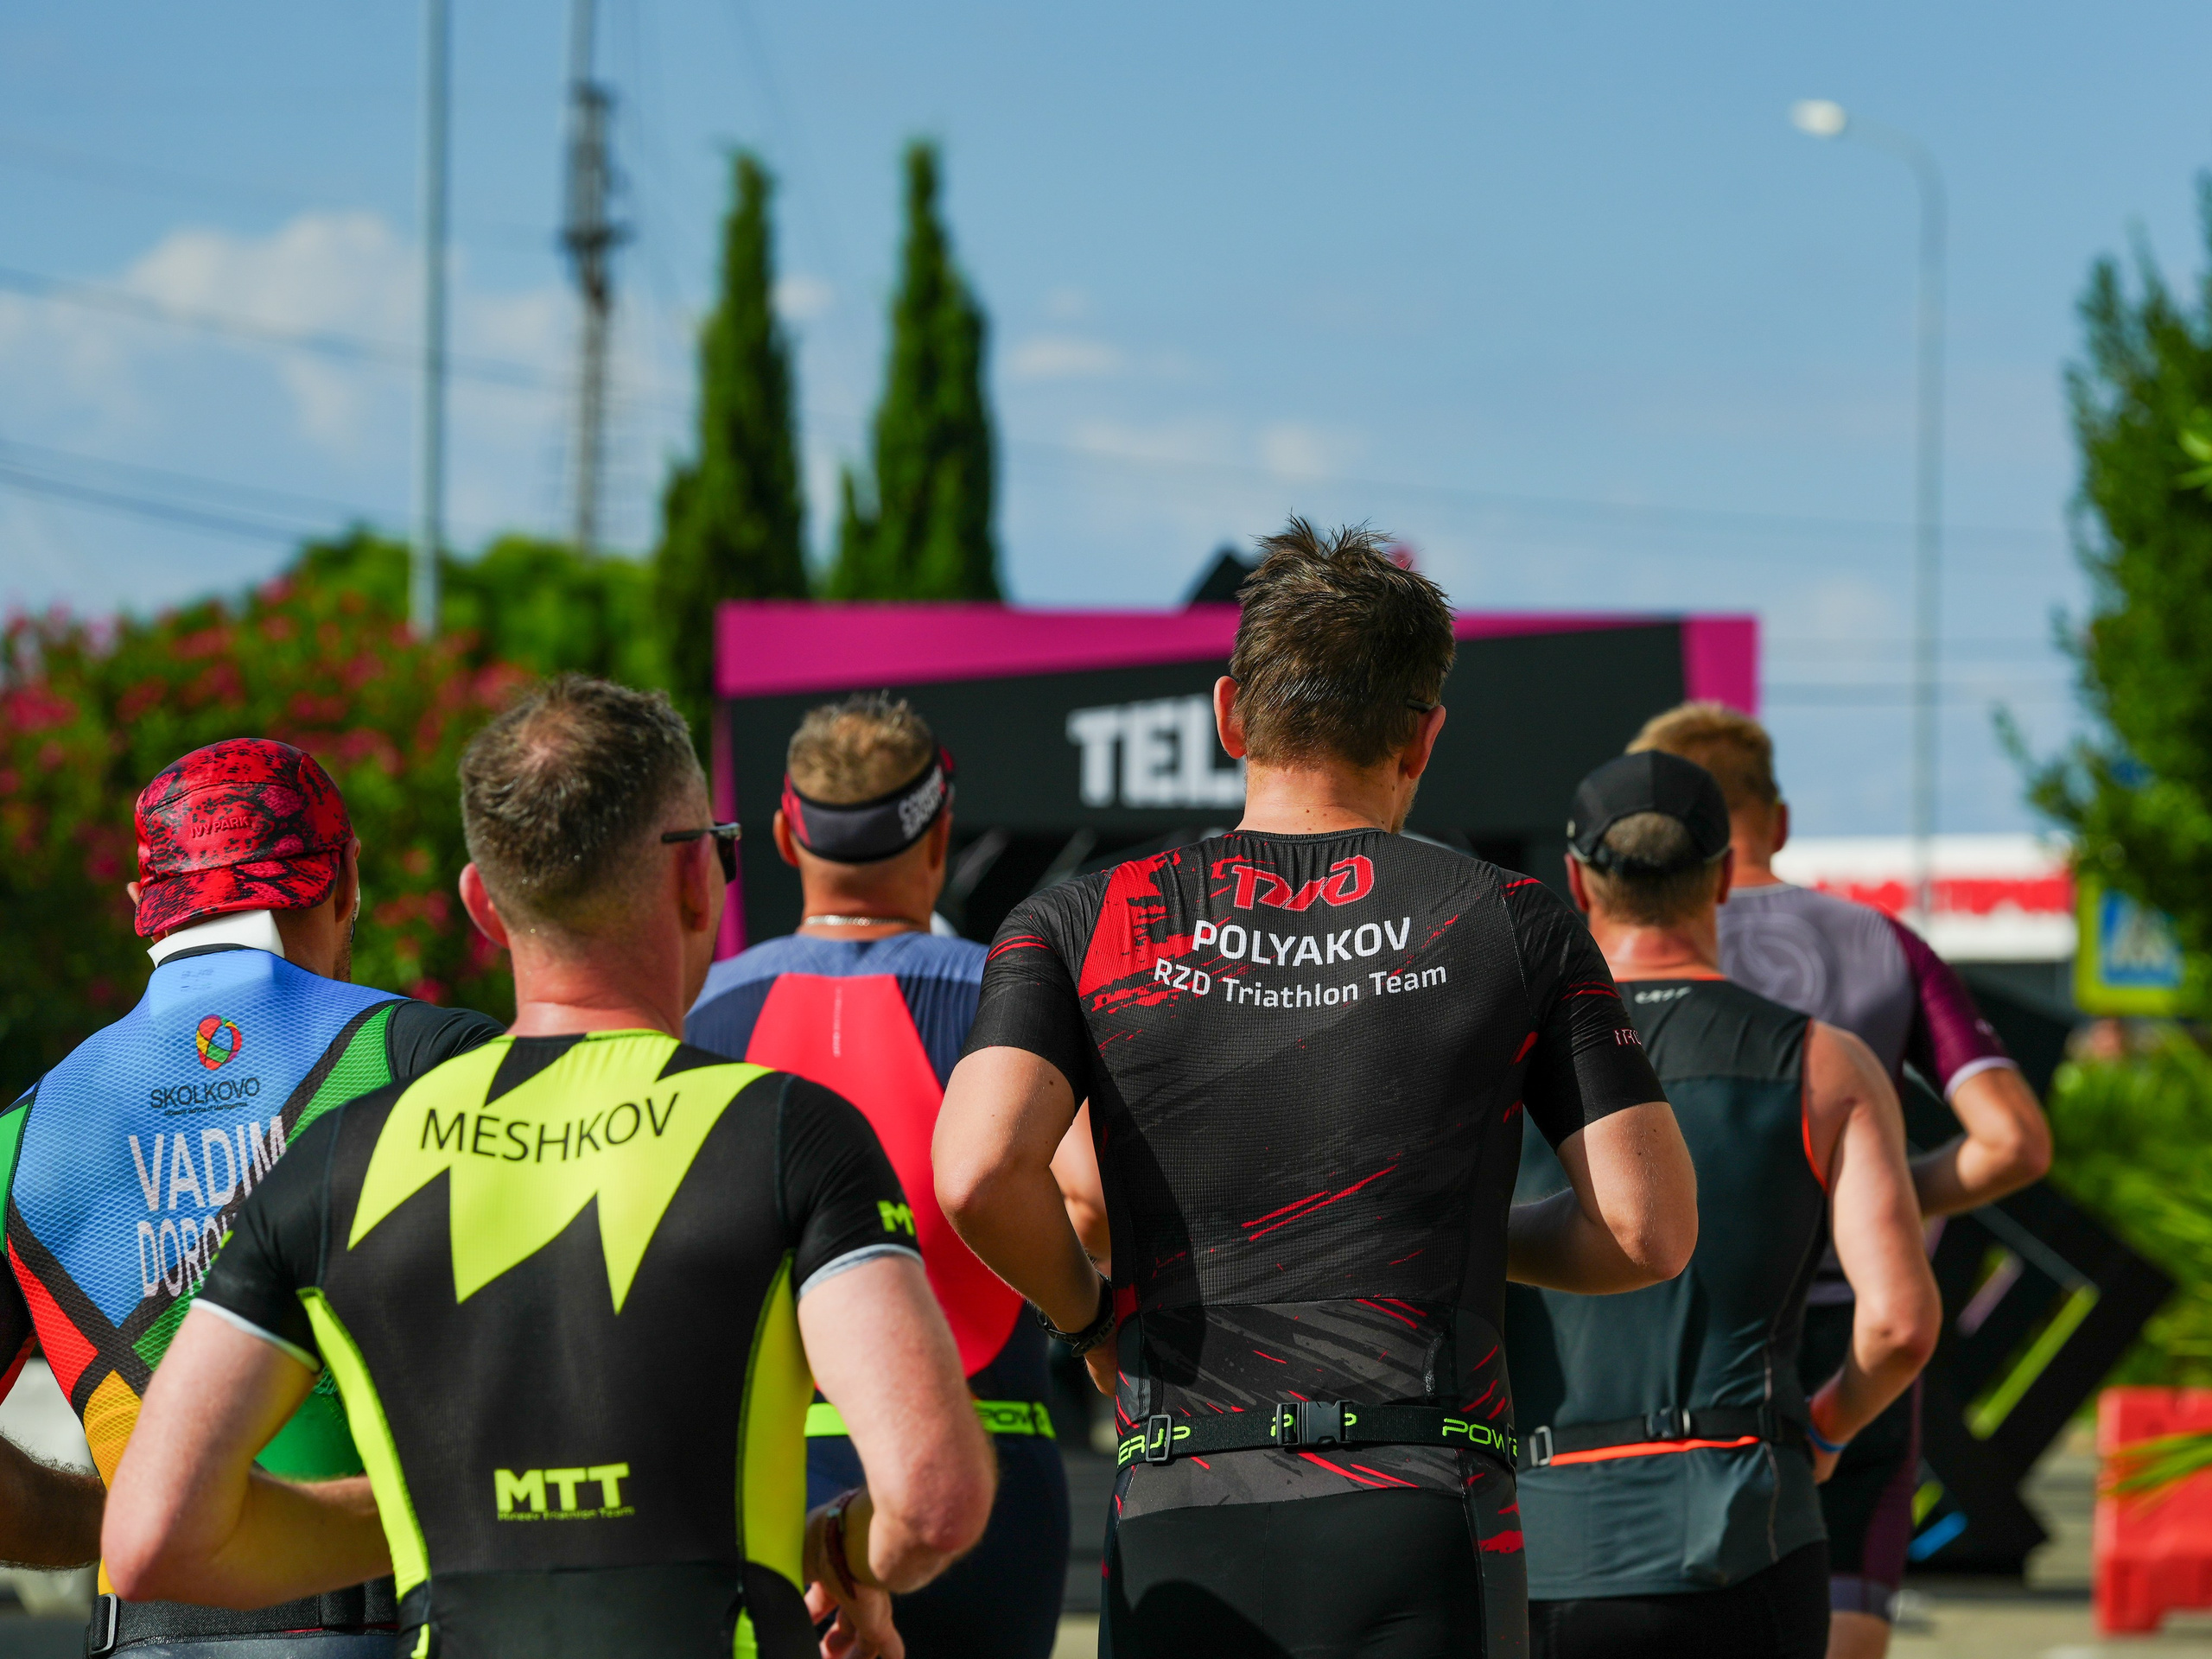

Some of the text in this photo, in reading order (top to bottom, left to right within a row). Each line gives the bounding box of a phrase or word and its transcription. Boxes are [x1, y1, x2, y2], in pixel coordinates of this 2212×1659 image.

[1066, 695, 1246, 808] TEL
[191, 816, 251, 838] IVY PARK
[1192, 917, 1410, 966] POLYAKOV
[1154, 957, 1447, 1008] RZD Triathlon Team
[149, 1077, 260, 1109] SKOLKOVO
[421, 1092, 679, 1163] MESHKOV
[128, 1116, 287, 1211] VADIM
[493, 1462, 631, 1512] MTT
